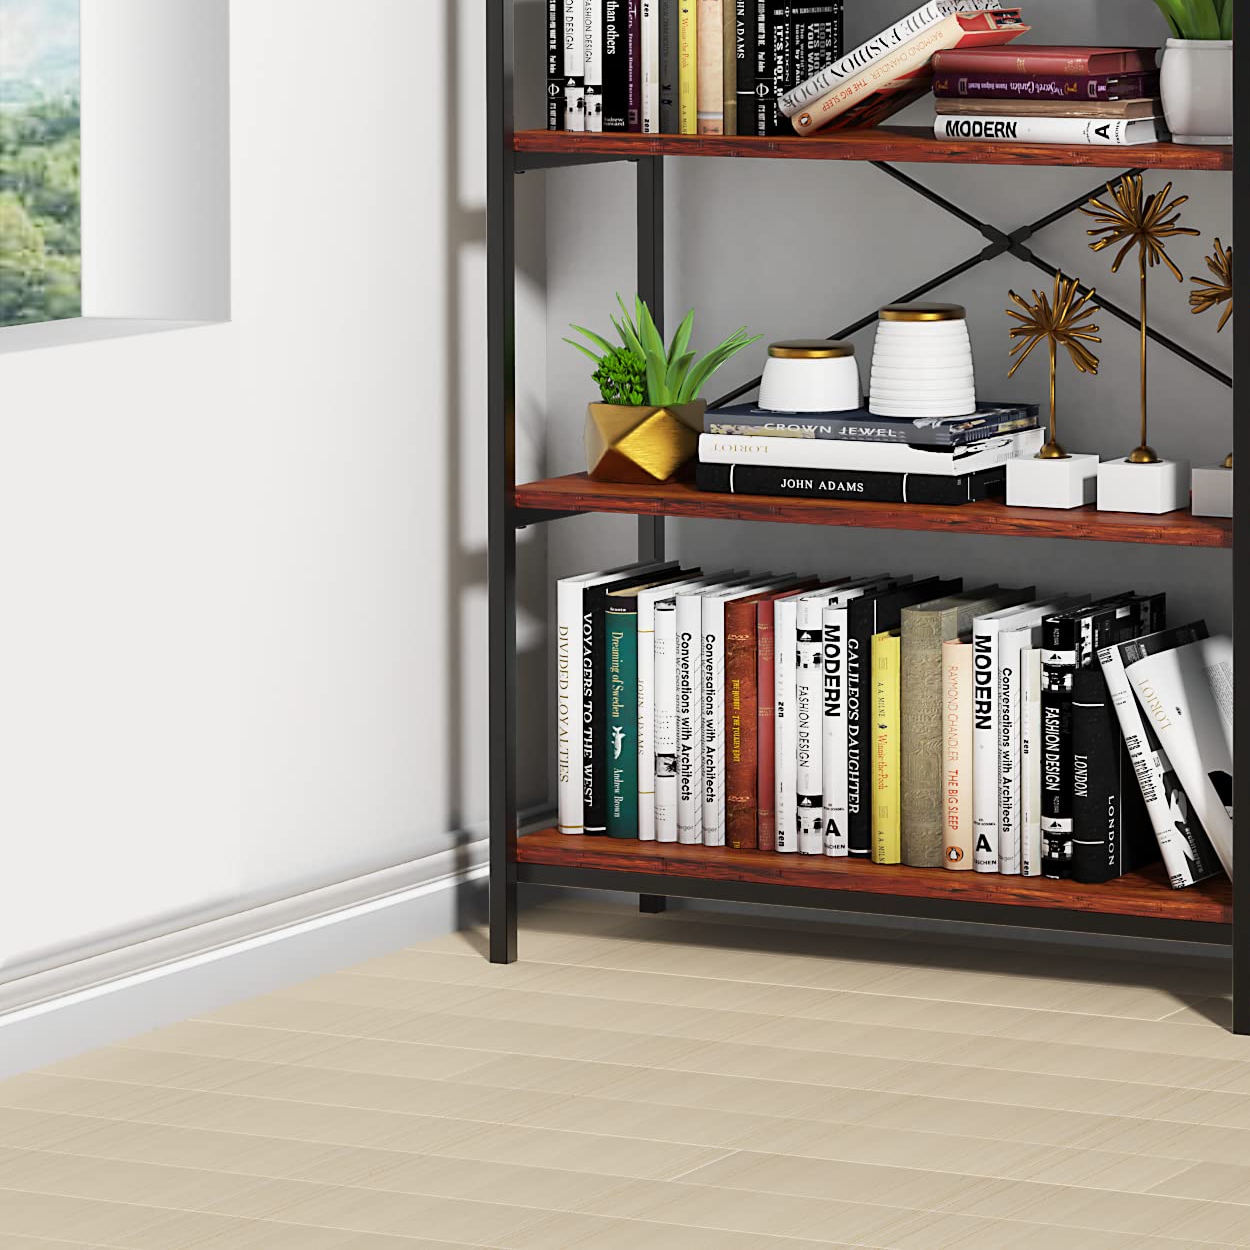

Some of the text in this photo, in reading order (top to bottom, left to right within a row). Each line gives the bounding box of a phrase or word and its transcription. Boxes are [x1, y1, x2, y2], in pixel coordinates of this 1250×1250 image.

[565, 16, 574, 50] DESIGN
[606, 0, 619, 22] than
[606, 24, 619, 55] others
[736, 20, 745, 59] ADAMS
[780, 7, 939, 108] THE FASHION BOOK
[945, 121, 1017, 138] MODERN
[1095, 124, 1110, 139] A
[764, 423, 897, 437] CROWN JEWEL
[781, 479, 864, 492] JOHN ADAMS
[824, 625, 840, 717] MODERN
[975, 635, 991, 729] MODERN
[560, 626, 568, 783] DIVIDED LOYALTIES
[584, 612, 592, 806] VOYAGERS TO THE WEST
[681, 632, 692, 800] Conversations with Architects
[799, 686, 809, 768] FASHION DESIGN
[848, 639, 860, 814] GALILEO'S DAUGHTER
[948, 666, 958, 830] RAYMOND CHANDLER THE BIG SLEEP
[1046, 706, 1059, 791] FASHION DESIGN
[1074, 754, 1087, 797] LONDON
[825, 819, 841, 836] A
[976, 834, 992, 852] A
[1107, 795, 1115, 866] LONDON
